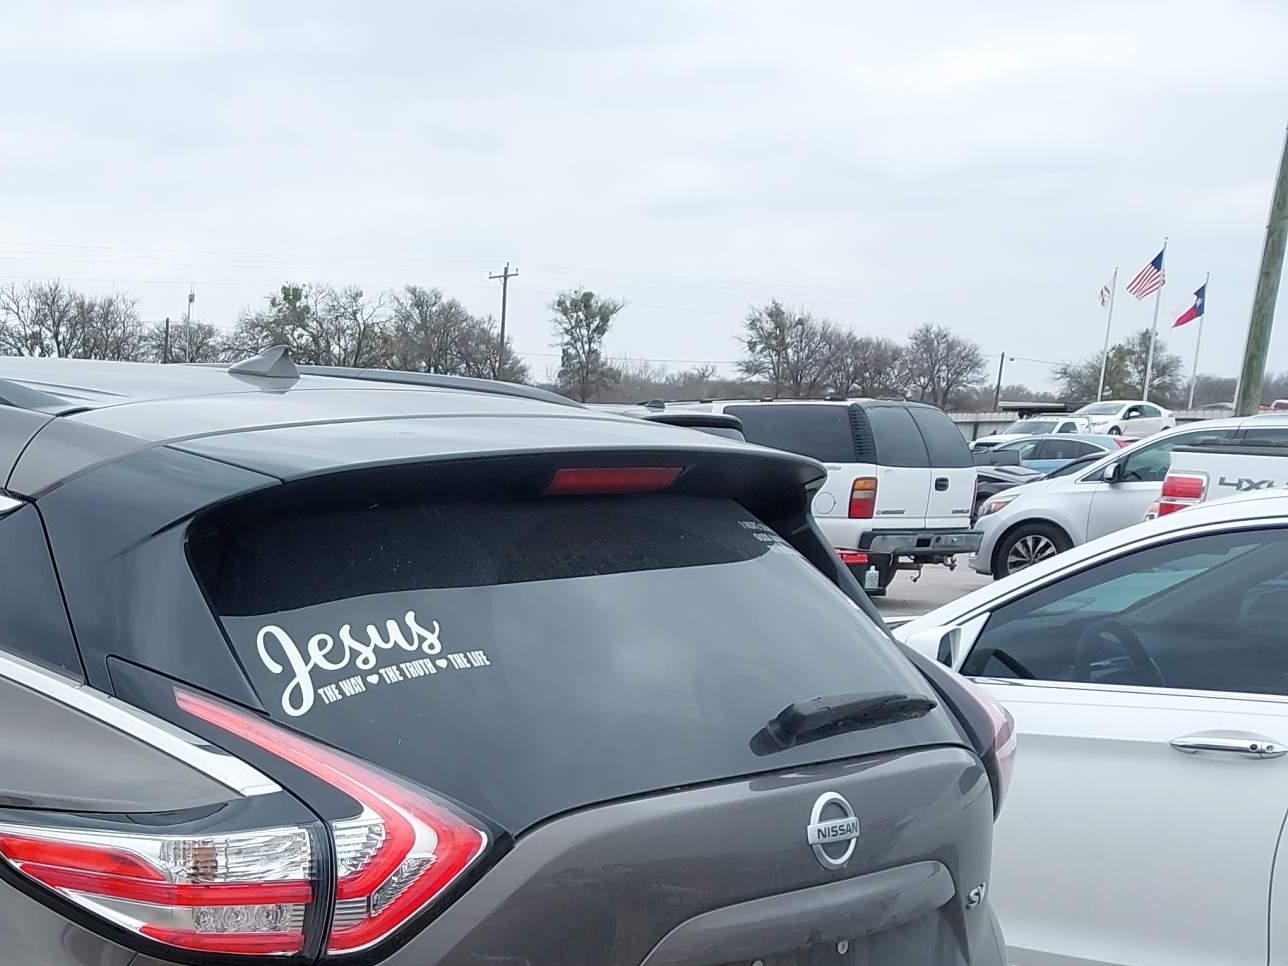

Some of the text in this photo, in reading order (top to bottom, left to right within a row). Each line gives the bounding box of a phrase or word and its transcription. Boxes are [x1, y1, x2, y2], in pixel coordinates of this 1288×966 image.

[256, 610, 440, 717] Jesus
[317, 649, 492, 705] THE WAY THE TRUTH THE LIFE
[817, 820, 859, 840] NISSAN
